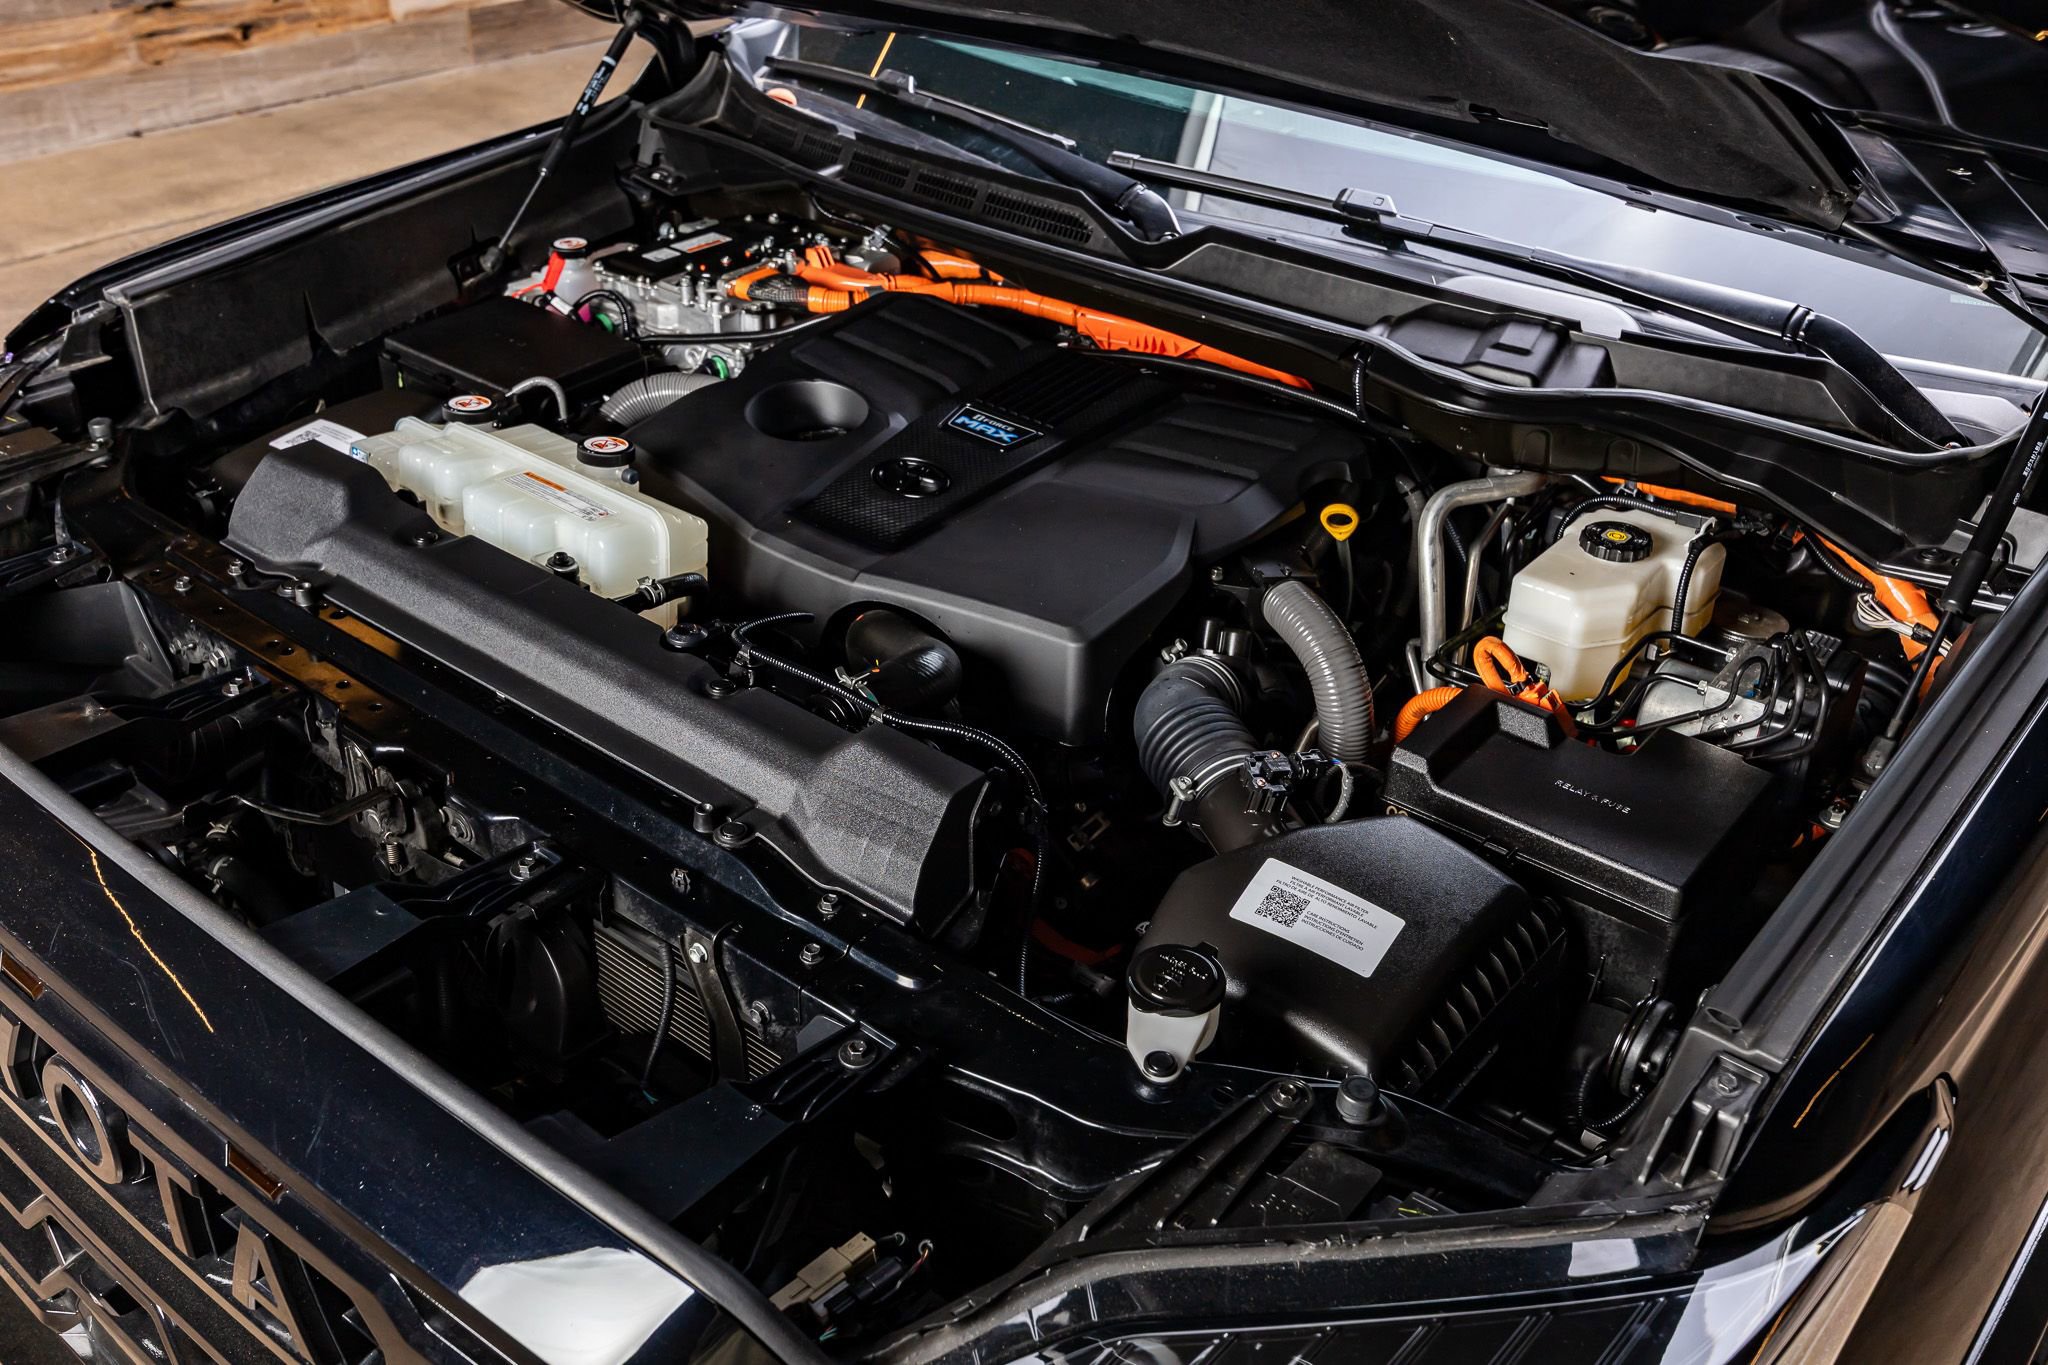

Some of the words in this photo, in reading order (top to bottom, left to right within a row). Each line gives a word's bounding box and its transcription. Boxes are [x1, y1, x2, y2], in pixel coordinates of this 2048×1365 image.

[954, 415, 1018, 442] MAX
[1554, 779, 1591, 797] RELAY
[1600, 798, 1631, 814] FUSE
[1315, 886, 1346, 903] PERFORMANCE
[1354, 904, 1368, 914] FILTER
[1315, 892, 1345, 908] PERFORMANT
[1344, 905, 1364, 917] LAVABLE
[1303, 914, 1335, 932] INSTRUCTIONS
[1306, 910, 1318, 918] CARE
[1318, 915, 1350, 934] INSTRUCTIONS
[1327, 902, 1357, 919] RENDIMIENTO
[1357, 917, 1377, 929] LAVABLE
[1301, 918, 1336, 937] INSTRUCCIONES
[1341, 937, 1363, 951] CUIDADO
